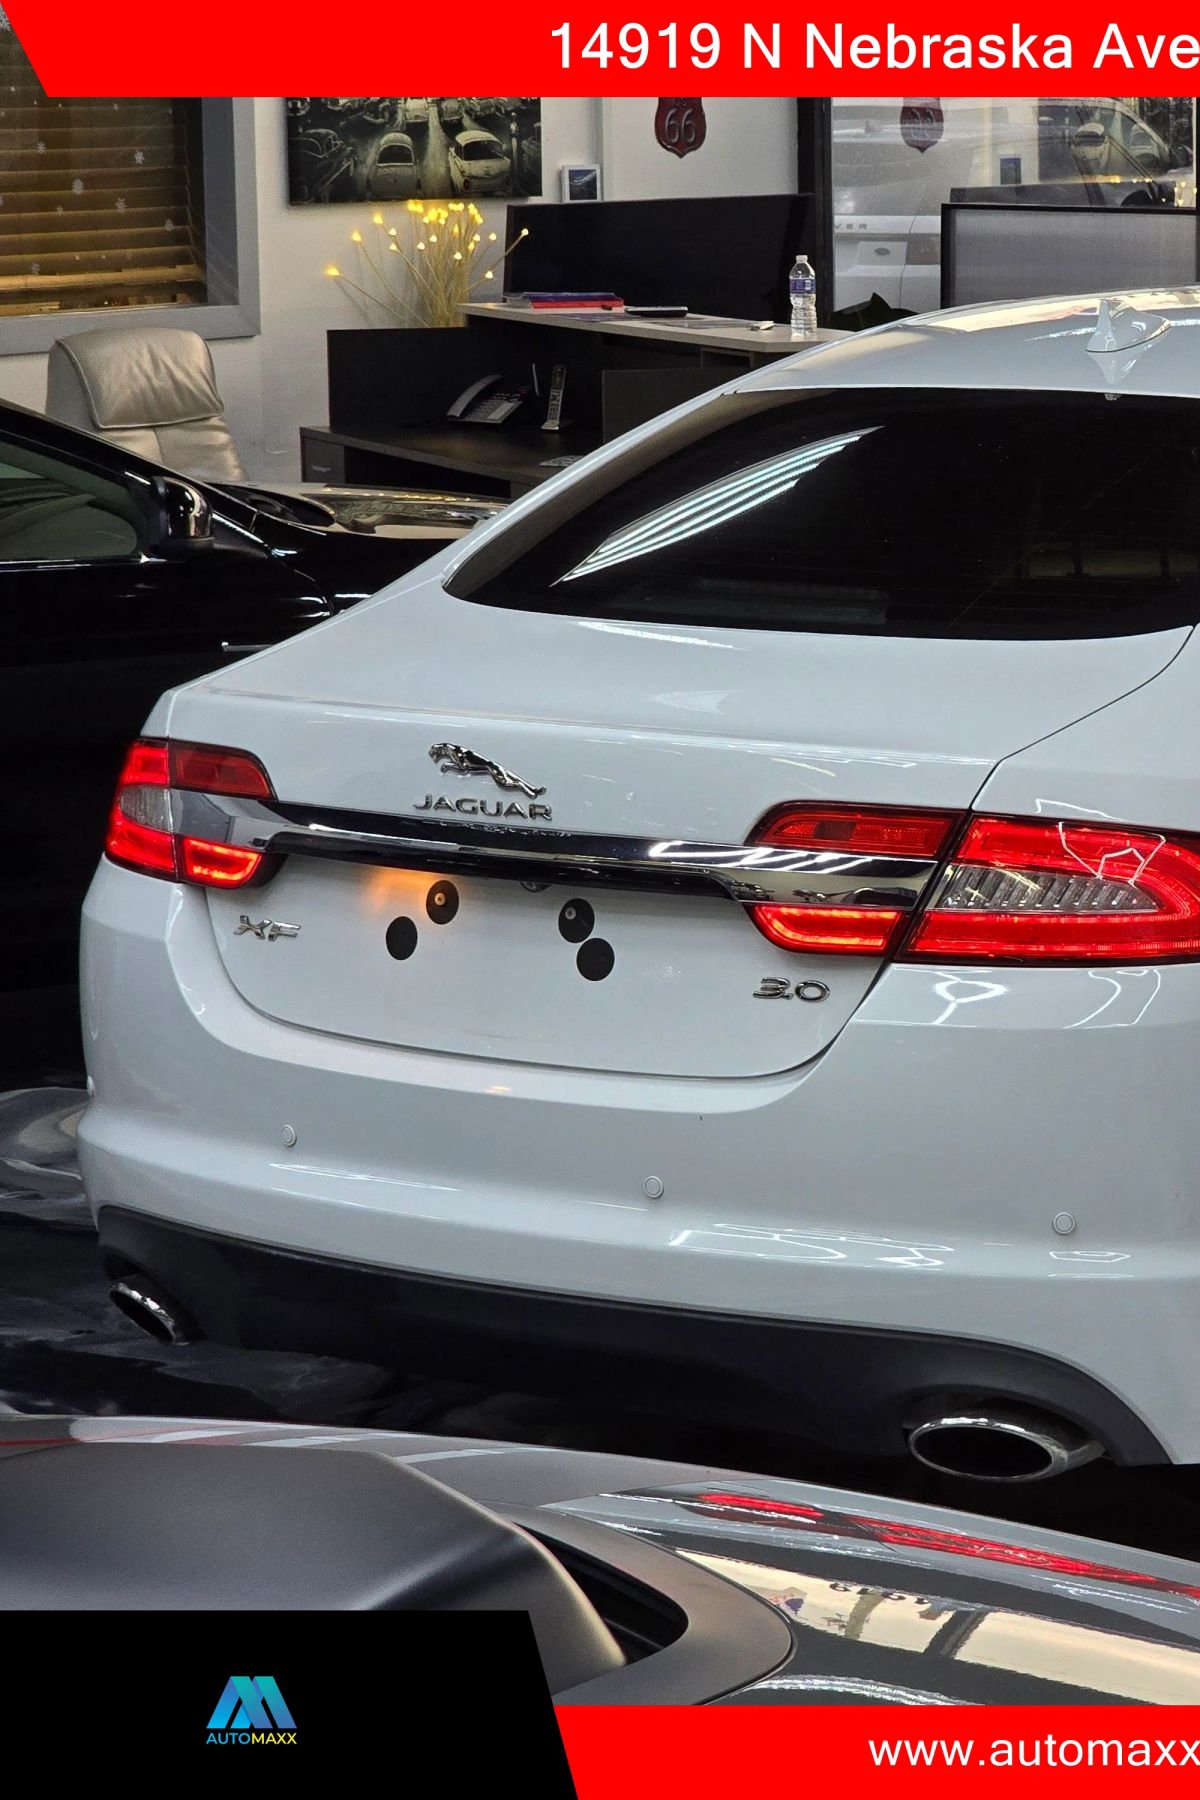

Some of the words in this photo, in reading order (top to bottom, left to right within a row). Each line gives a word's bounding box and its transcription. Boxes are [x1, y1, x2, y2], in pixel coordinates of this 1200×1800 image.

[665, 108, 696, 143] 66
[413, 794, 553, 821] JAGUAR
[233, 915, 302, 942] XF
[752, 976, 831, 1003] 3.0
